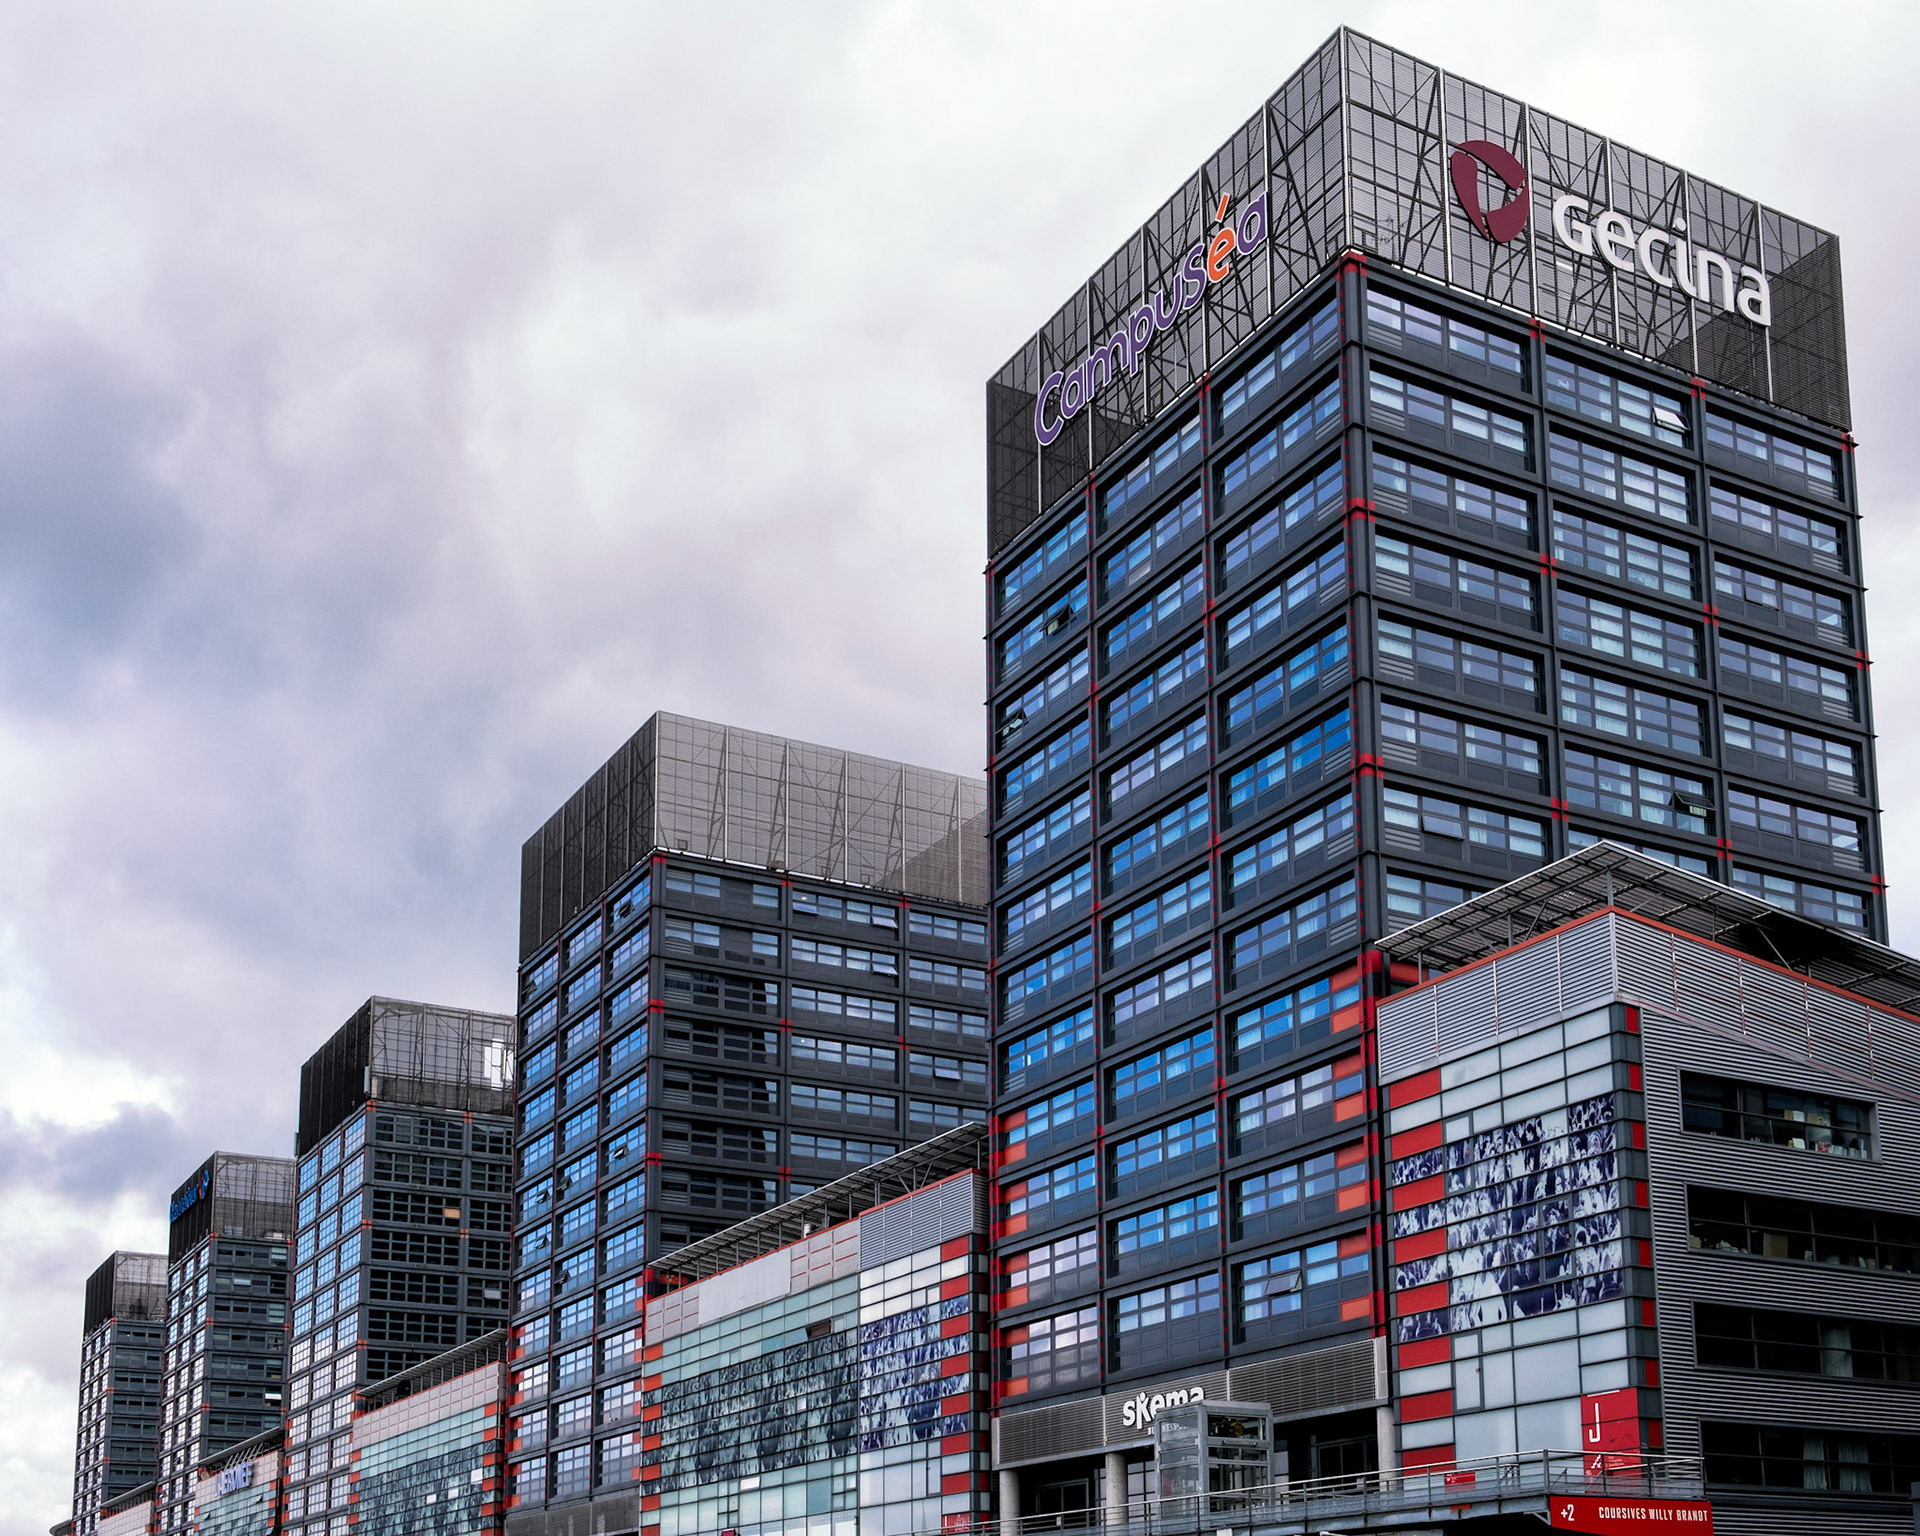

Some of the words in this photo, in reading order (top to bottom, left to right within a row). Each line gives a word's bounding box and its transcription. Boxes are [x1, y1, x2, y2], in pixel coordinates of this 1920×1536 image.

[1552, 193, 1772, 327] Gecina
[1034, 191, 1269, 446] Campuséa
[1122, 1386, 1205, 1430] skema
[1588, 1402, 1601, 1443] J
[1560, 1504, 1575, 1522] +2
[1598, 1506, 1647, 1520] COURSIVES
[1648, 1508, 1673, 1521] WILLY
[1676, 1509, 1708, 1522] BRANDT
